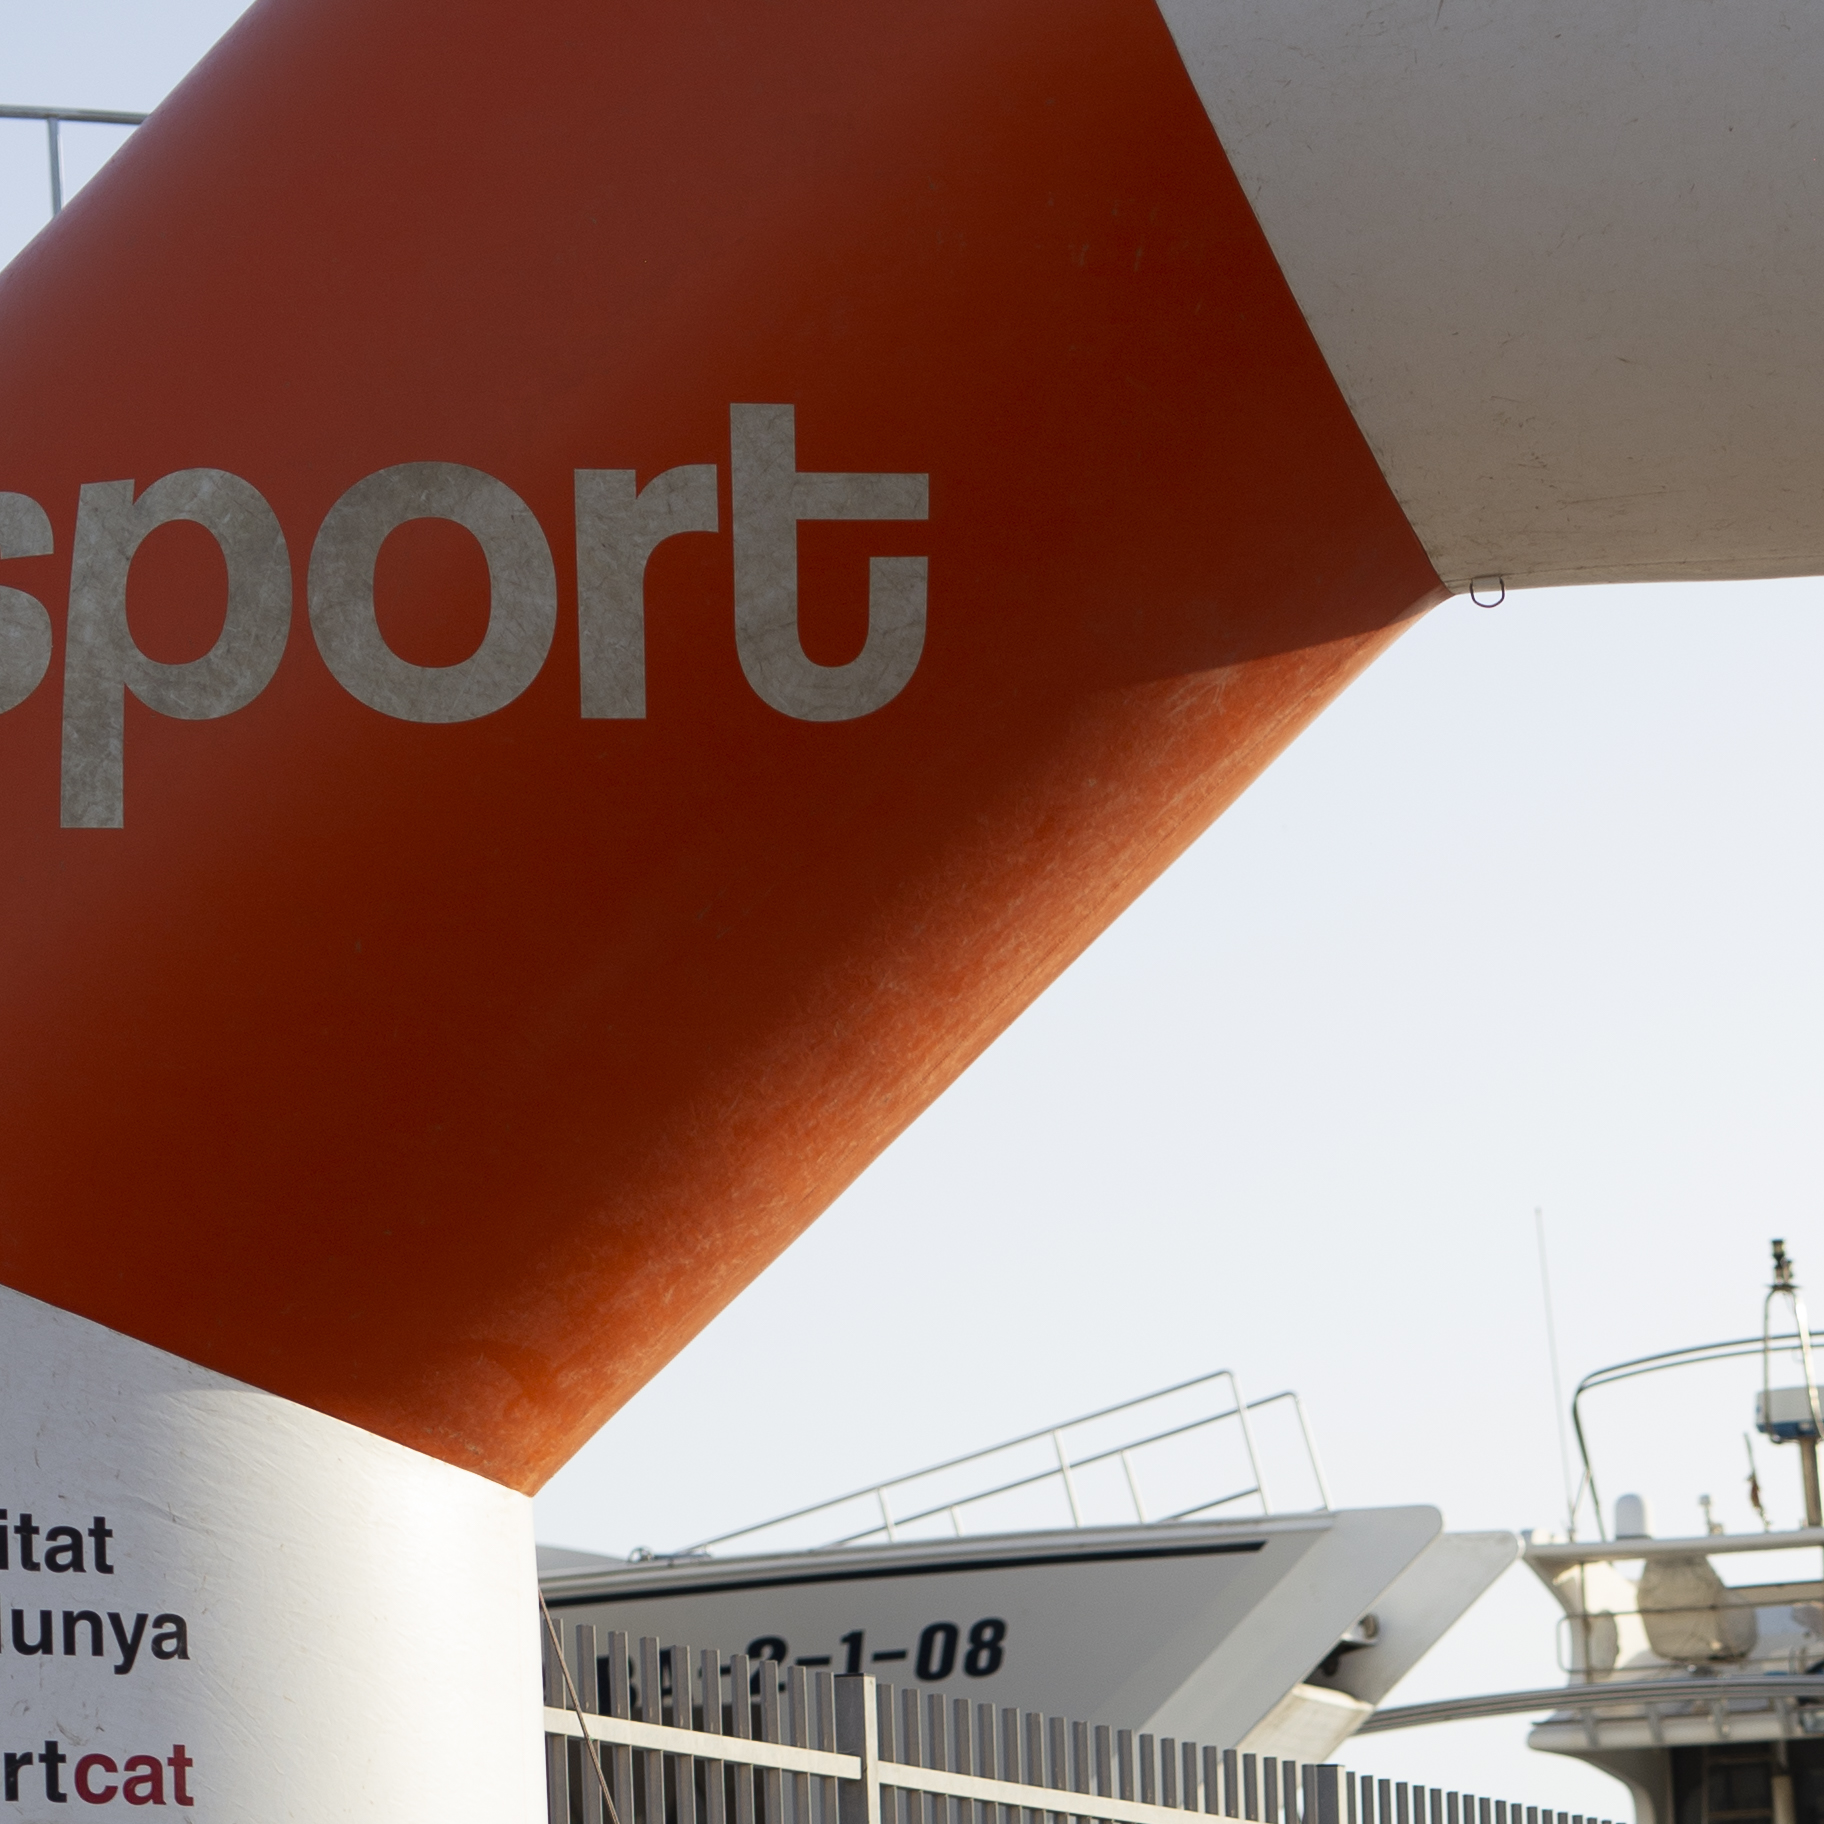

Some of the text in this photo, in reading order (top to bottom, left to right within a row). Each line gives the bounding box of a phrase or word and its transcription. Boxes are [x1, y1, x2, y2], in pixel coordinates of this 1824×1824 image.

[0, 403, 930, 829] port
[0, 1509, 115, 1574] itat
[0, 1605, 191, 1675] unya
[4, 1740, 194, 1806] rtcat
